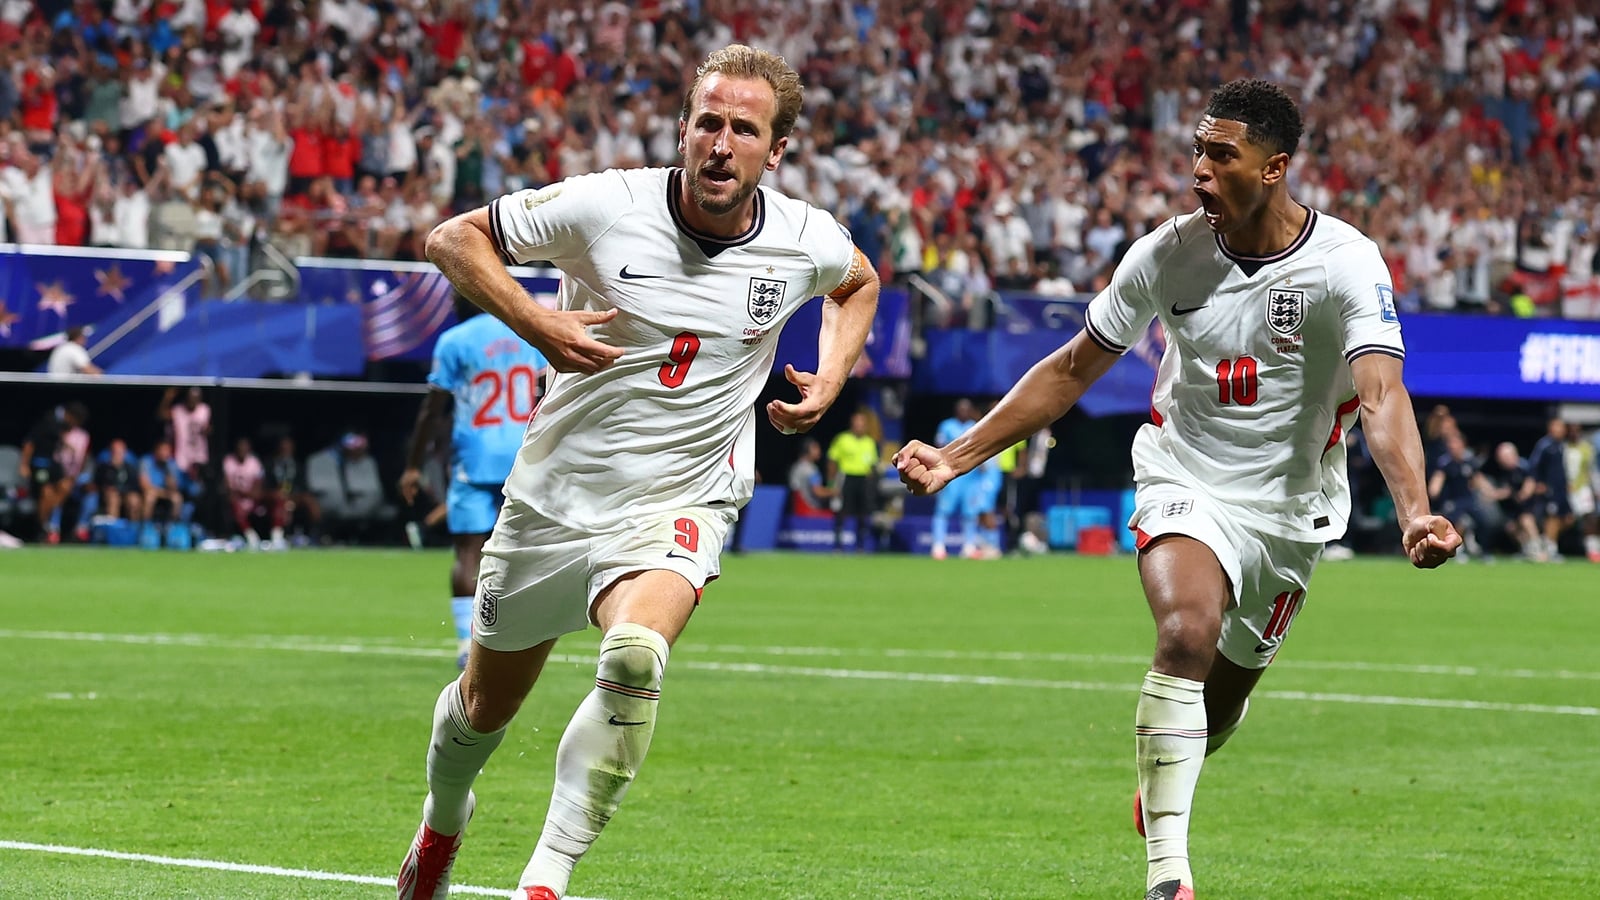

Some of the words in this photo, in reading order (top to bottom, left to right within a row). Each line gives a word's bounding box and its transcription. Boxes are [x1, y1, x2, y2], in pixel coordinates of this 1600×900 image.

[658, 331, 701, 389] 9
[1215, 356, 1258, 406] 10
[472, 364, 535, 427] 20
[674, 518, 699, 553] 9
